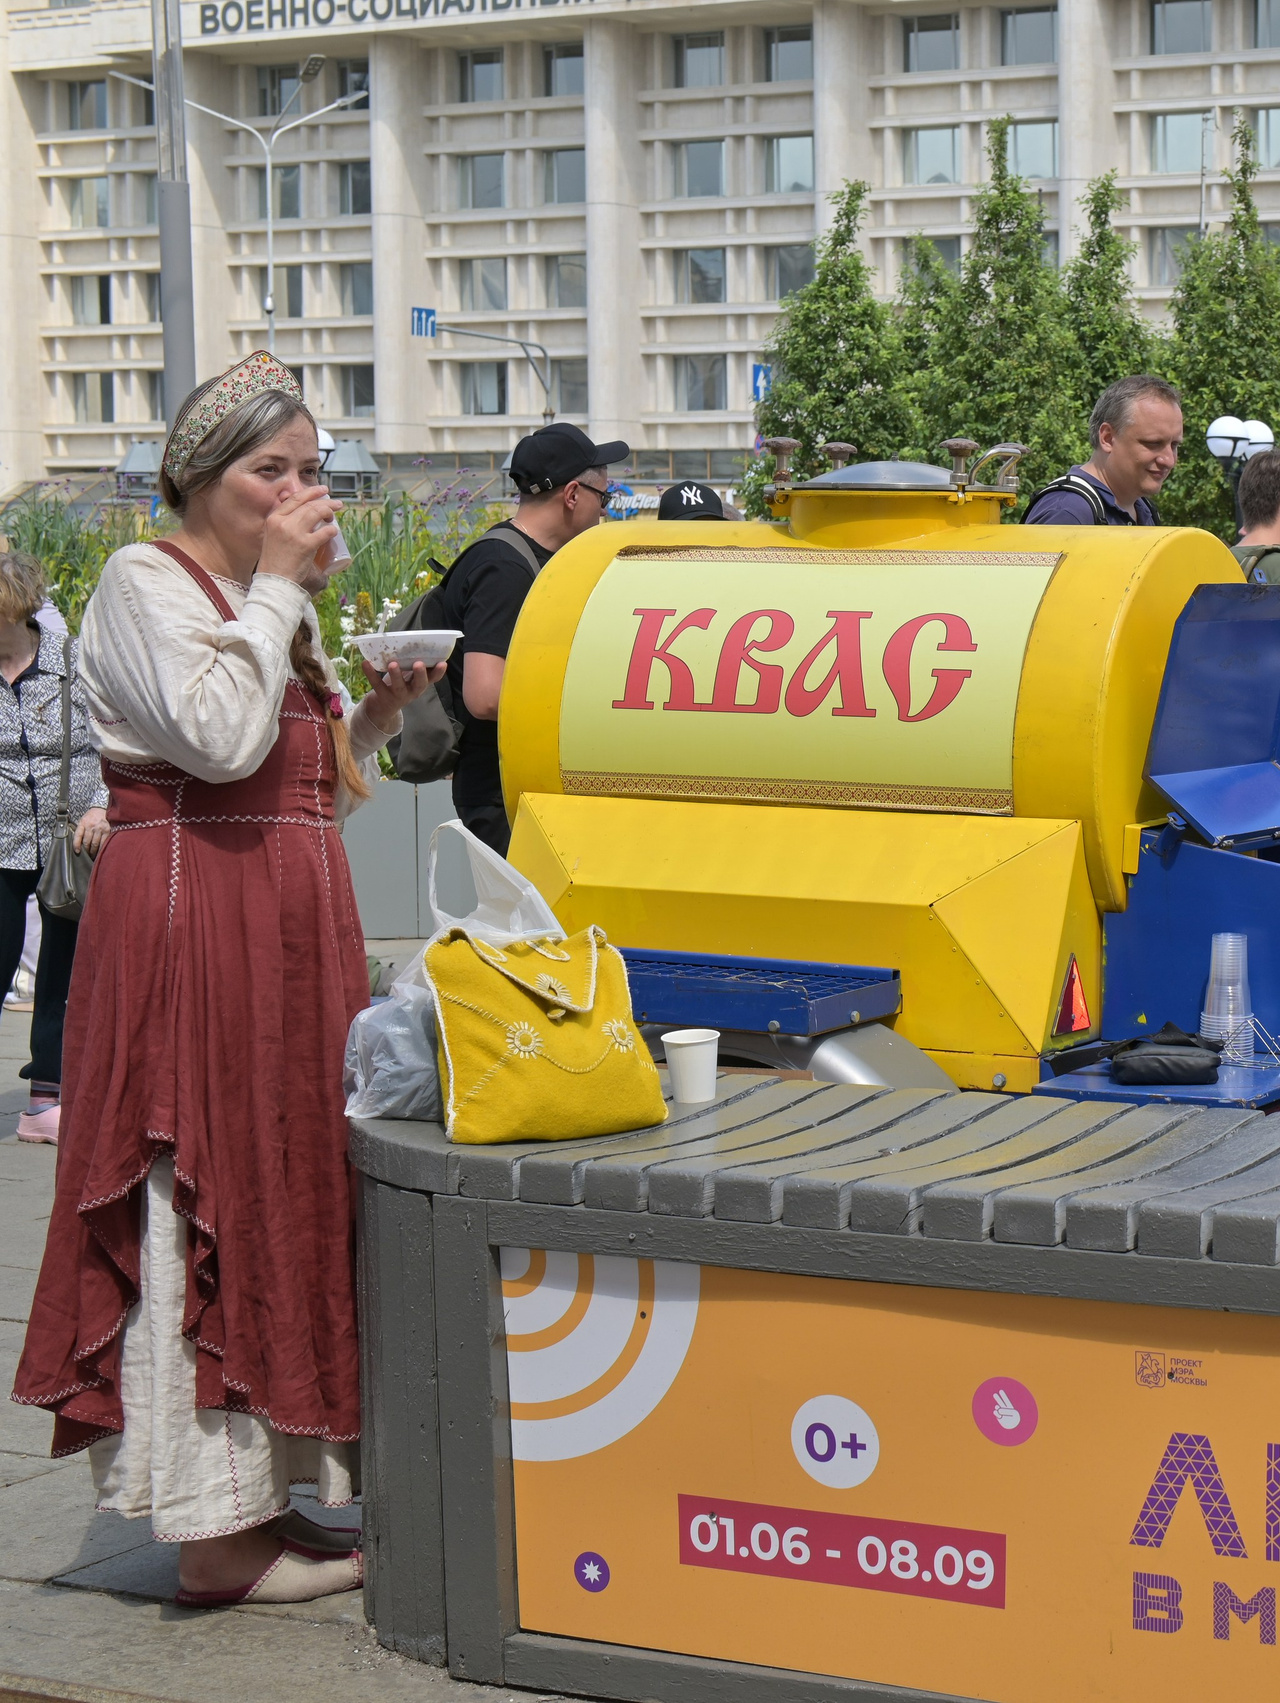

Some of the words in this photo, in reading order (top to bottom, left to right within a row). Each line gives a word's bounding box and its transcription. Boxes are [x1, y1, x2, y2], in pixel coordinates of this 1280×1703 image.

[611, 608, 978, 722] КВАС
[1170, 1358, 1203, 1368] ПРОЕКТ
[1170, 1367, 1194, 1376] МЭРА
[1170, 1377, 1208, 1386] МОСКВЫ
[804, 1423, 867, 1462] 0+
[690, 1514, 811, 1565] 01.06
[856, 1535, 995, 1589] 08.09
[1133, 1572, 1183, 1634] В
